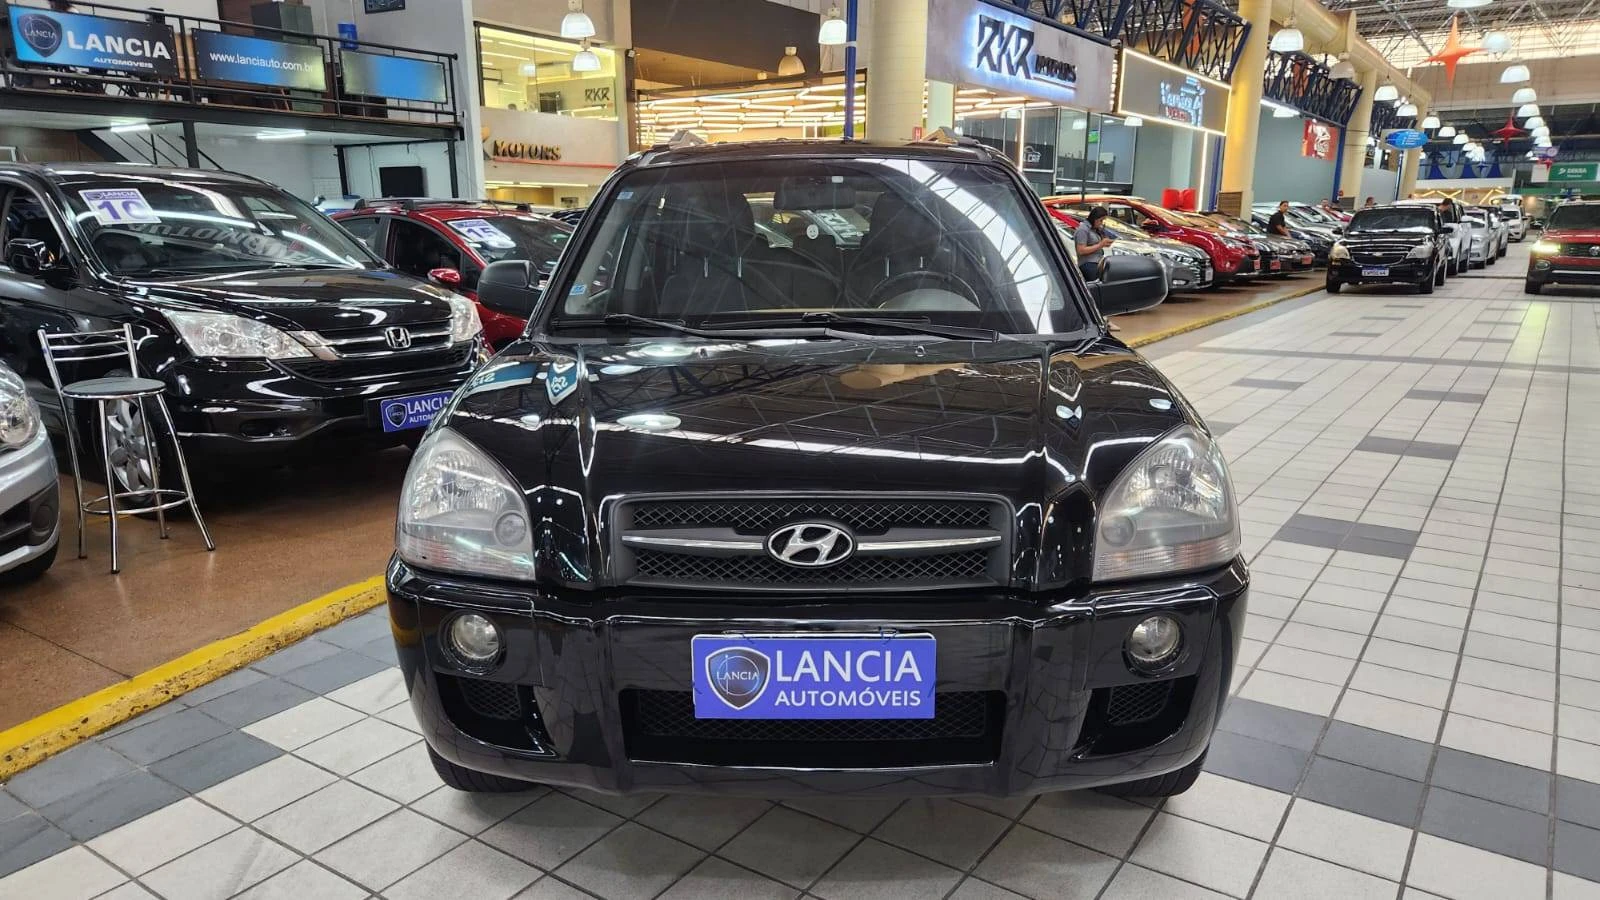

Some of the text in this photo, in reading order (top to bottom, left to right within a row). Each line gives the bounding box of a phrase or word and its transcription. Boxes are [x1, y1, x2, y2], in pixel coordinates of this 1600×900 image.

[24, 29, 58, 39] LANCIA
[67, 30, 172, 60] LANCIA
[976, 14, 1035, 80] RKR
[209, 52, 313, 73] www.lanciauto.com.br
[584, 87, 610, 101] RKR
[493, 140, 562, 161] MOTORS
[716, 671, 759, 681] LANCIA
[776, 650, 922, 682] LANCIA
[774, 686, 921, 706] AUTOMÓVEIS
